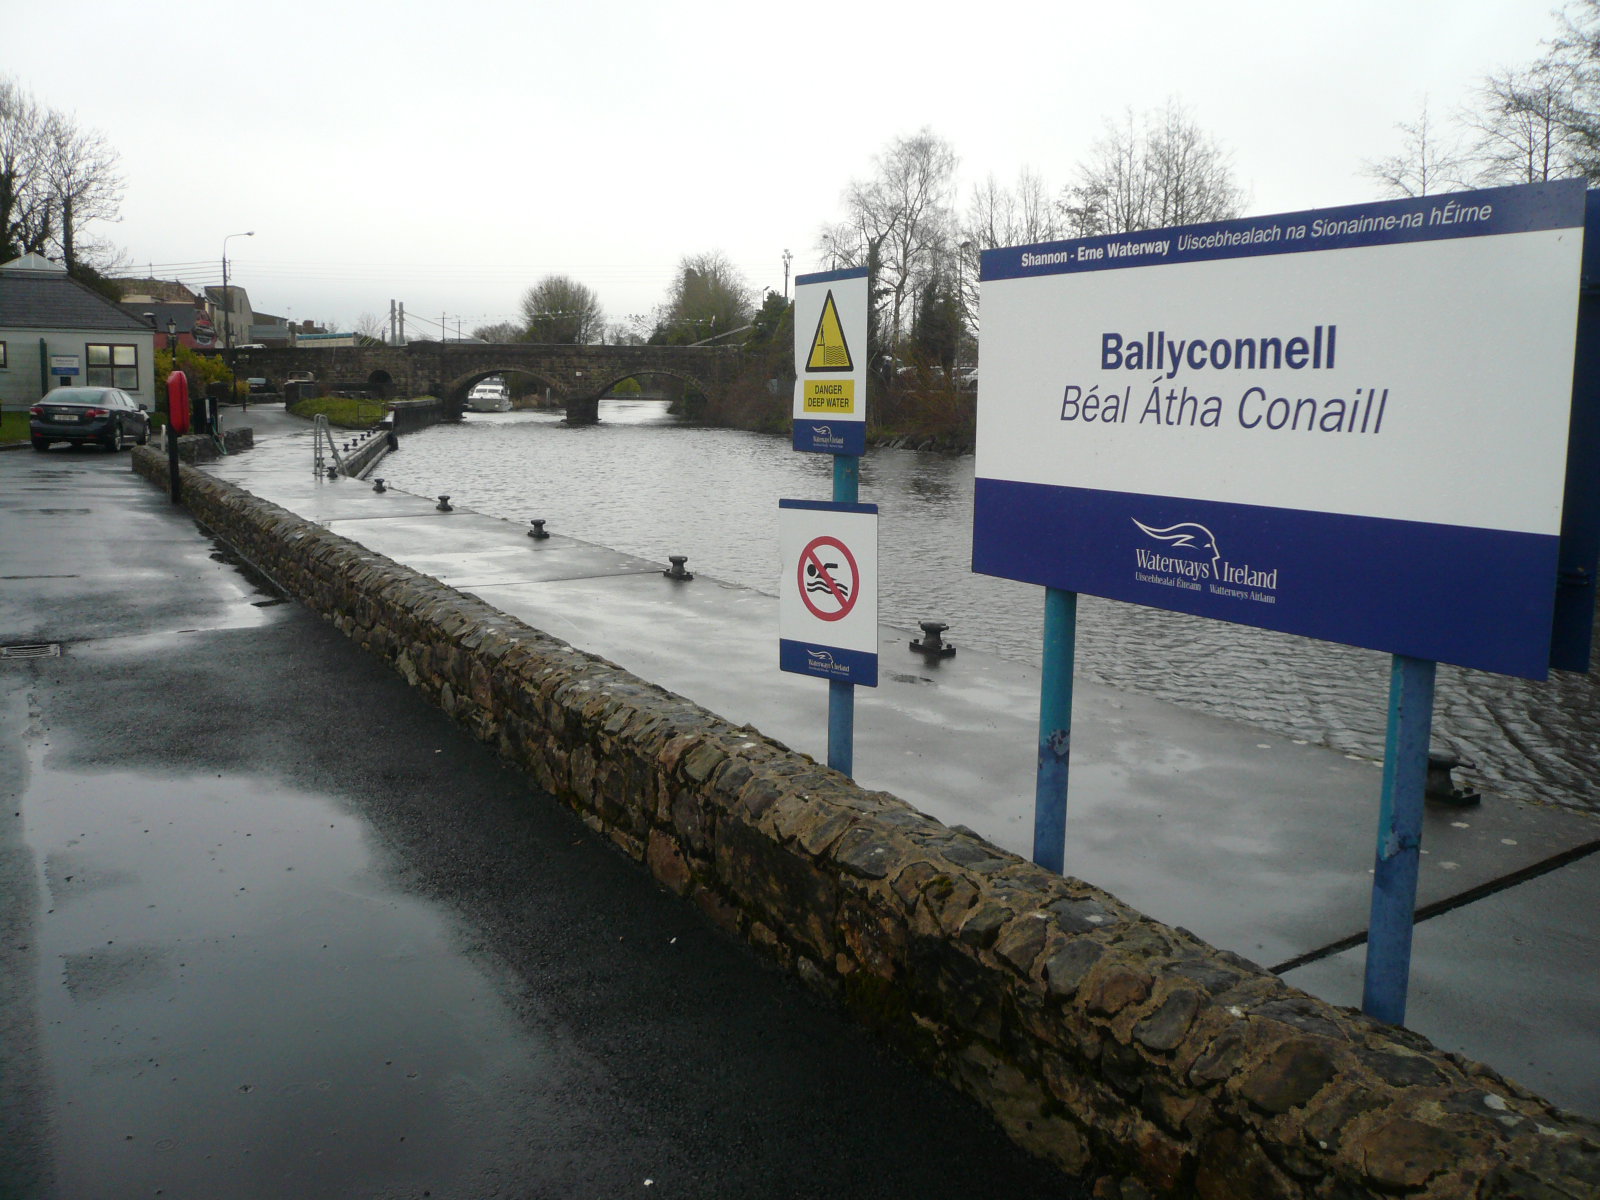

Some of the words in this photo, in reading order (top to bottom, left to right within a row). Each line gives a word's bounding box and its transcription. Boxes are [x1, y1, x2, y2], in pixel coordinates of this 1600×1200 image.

[1021, 252, 1068, 267] Shannon
[1077, 246, 1104, 262] Erne
[1107, 238, 1170, 258] Waterway
[1177, 224, 1281, 251] Uiscebhealach
[1285, 222, 1306, 240] na
[1428, 200, 1492, 227] hÉirne
[1100, 324, 1337, 379] Ballyconnell
[807, 397, 825, 407] DEEP
[826, 397, 849, 408] WATER
[814, 384, 843, 395] DANGER
[1059, 383, 1131, 424] Béal
[1138, 375, 1223, 428] Átha
[1237, 386, 1389, 434] Conaill
[1135, 548, 1210, 581] Waterways
[1223, 561, 1278, 590] Ireland
[1249, 590, 1276, 604] Airlann
